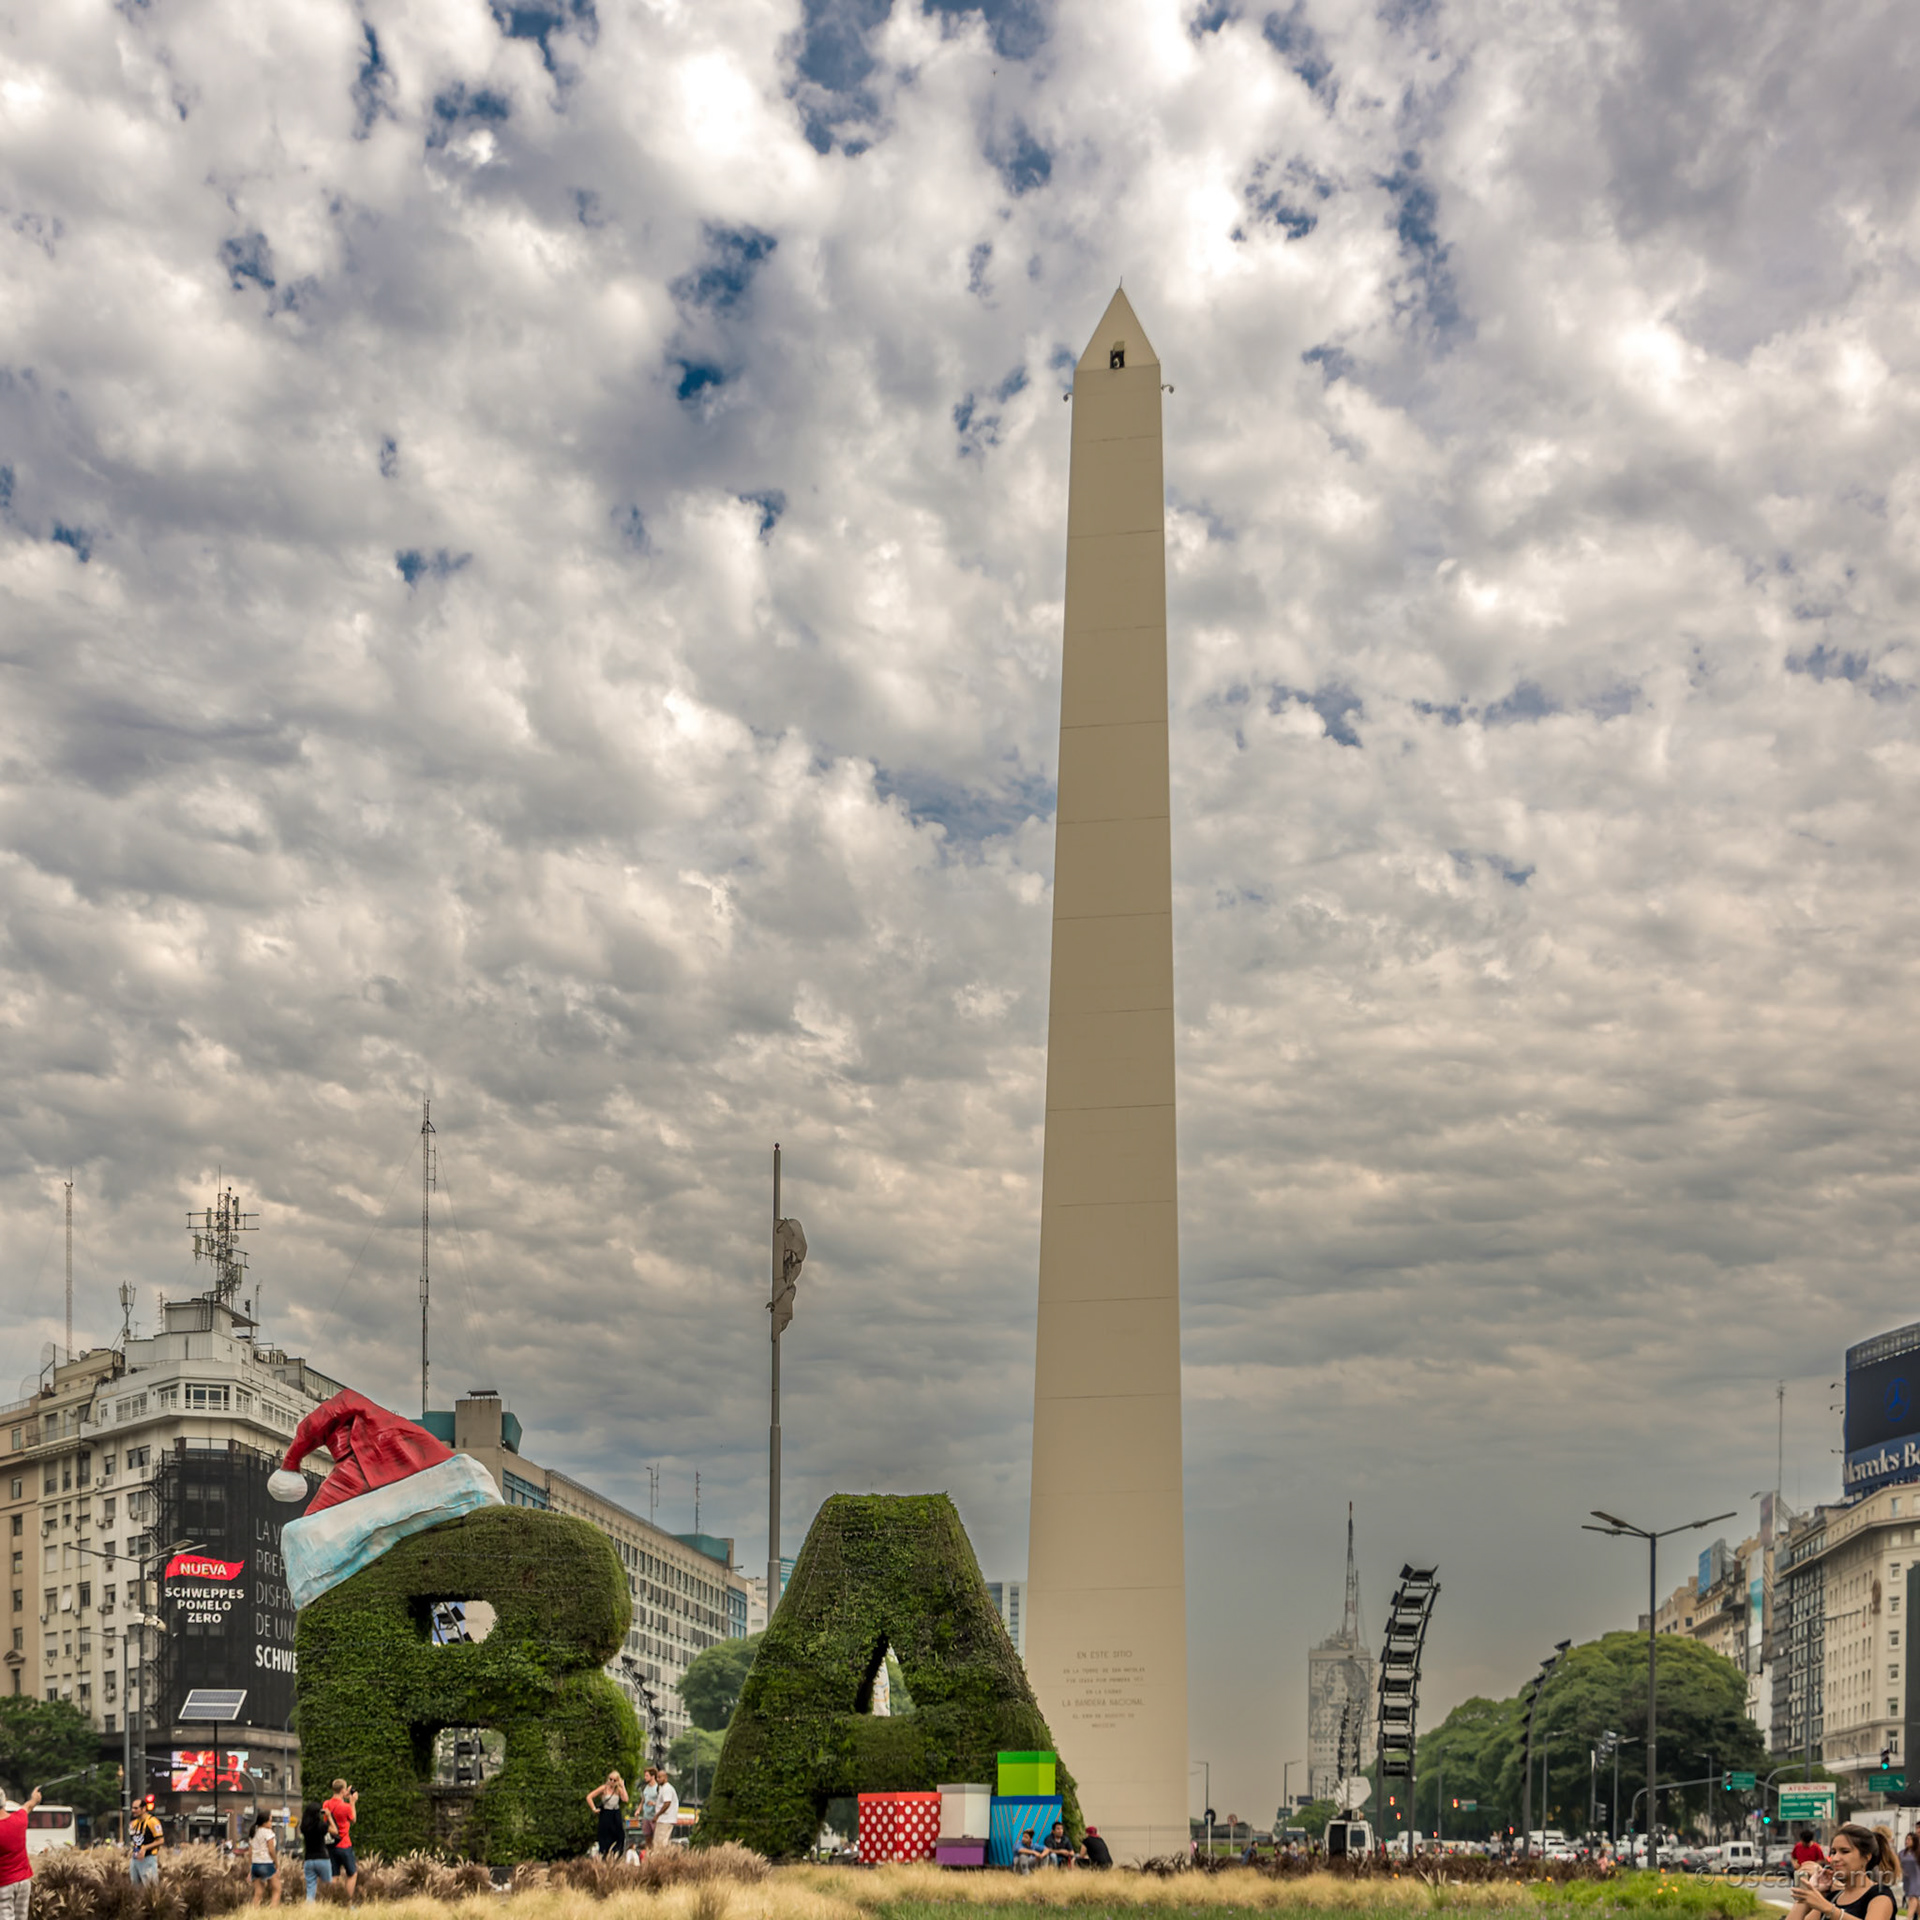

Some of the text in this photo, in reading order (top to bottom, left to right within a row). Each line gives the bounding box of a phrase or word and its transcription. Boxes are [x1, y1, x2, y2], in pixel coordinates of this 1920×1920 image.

[256, 1517, 281, 1545] LA V
[180, 1563, 227, 1575] NUEVA
[165, 1587, 245, 1599] SCHWEPPES
[256, 1581, 296, 1612] DISFRU
[177, 1600, 232, 1611] POMELO
[187, 1612, 222, 1623] ZERO
[256, 1612, 271, 1637] DE
[255, 1644, 298, 1674] SCHWE
[1077, 1650, 1133, 1659] EN ESTE SITIO
